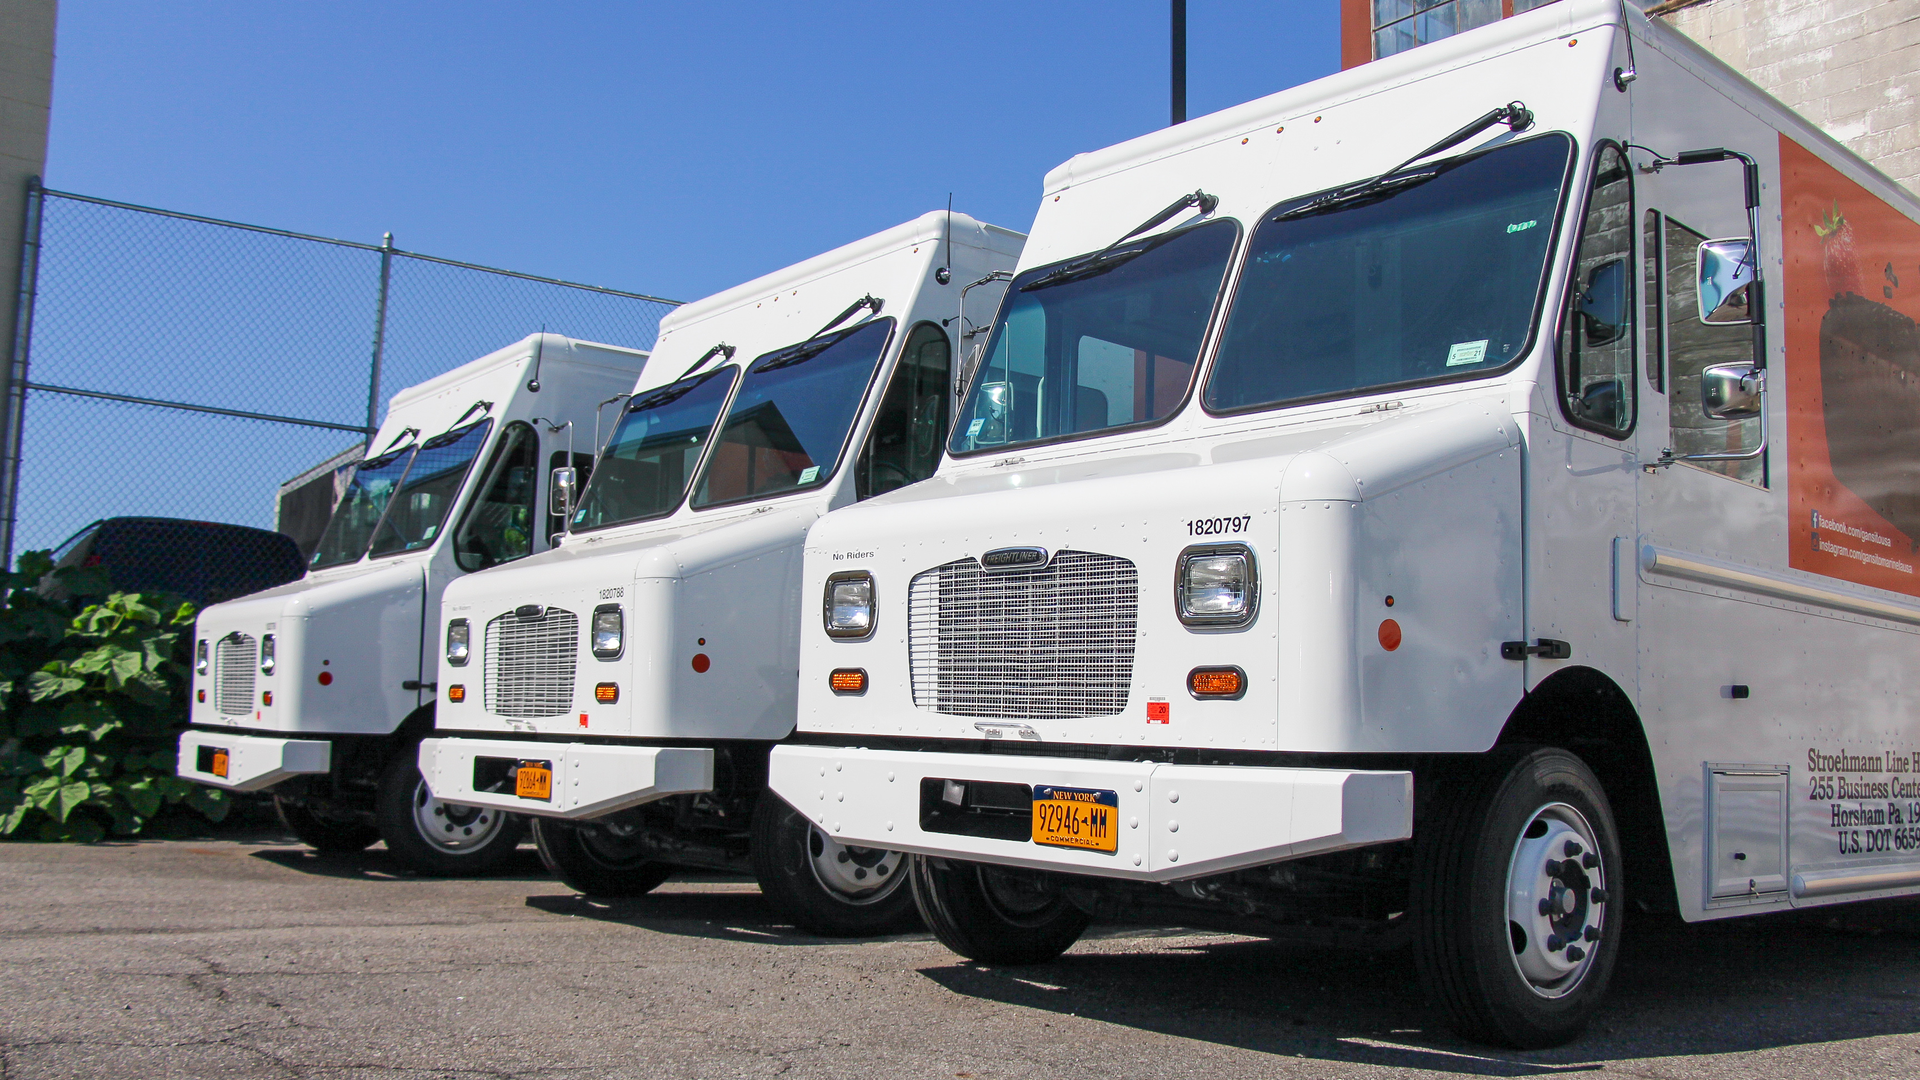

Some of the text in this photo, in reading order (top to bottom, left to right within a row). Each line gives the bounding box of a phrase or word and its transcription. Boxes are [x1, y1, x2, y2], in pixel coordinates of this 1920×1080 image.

[1187, 515, 1251, 536] 1820797
[847, 551, 874, 560] Riders
[986, 551, 1037, 563] FREIGHTLINER
[1808, 748, 1882, 773] Stroehmann
[1885, 750, 1909, 773] Line
[1053, 791, 1096, 803] NEW YORK
[1809, 776, 1834, 800] 255
[1838, 776, 1888, 800] Business
[1831, 803, 1885, 827] Horsham
[1888, 802, 1903, 825] Pa.
[1050, 835, 1094, 846] COMMERCIAL
[1838, 830, 1862, 854] U.S.
[1866, 829, 1891, 852] DOT
